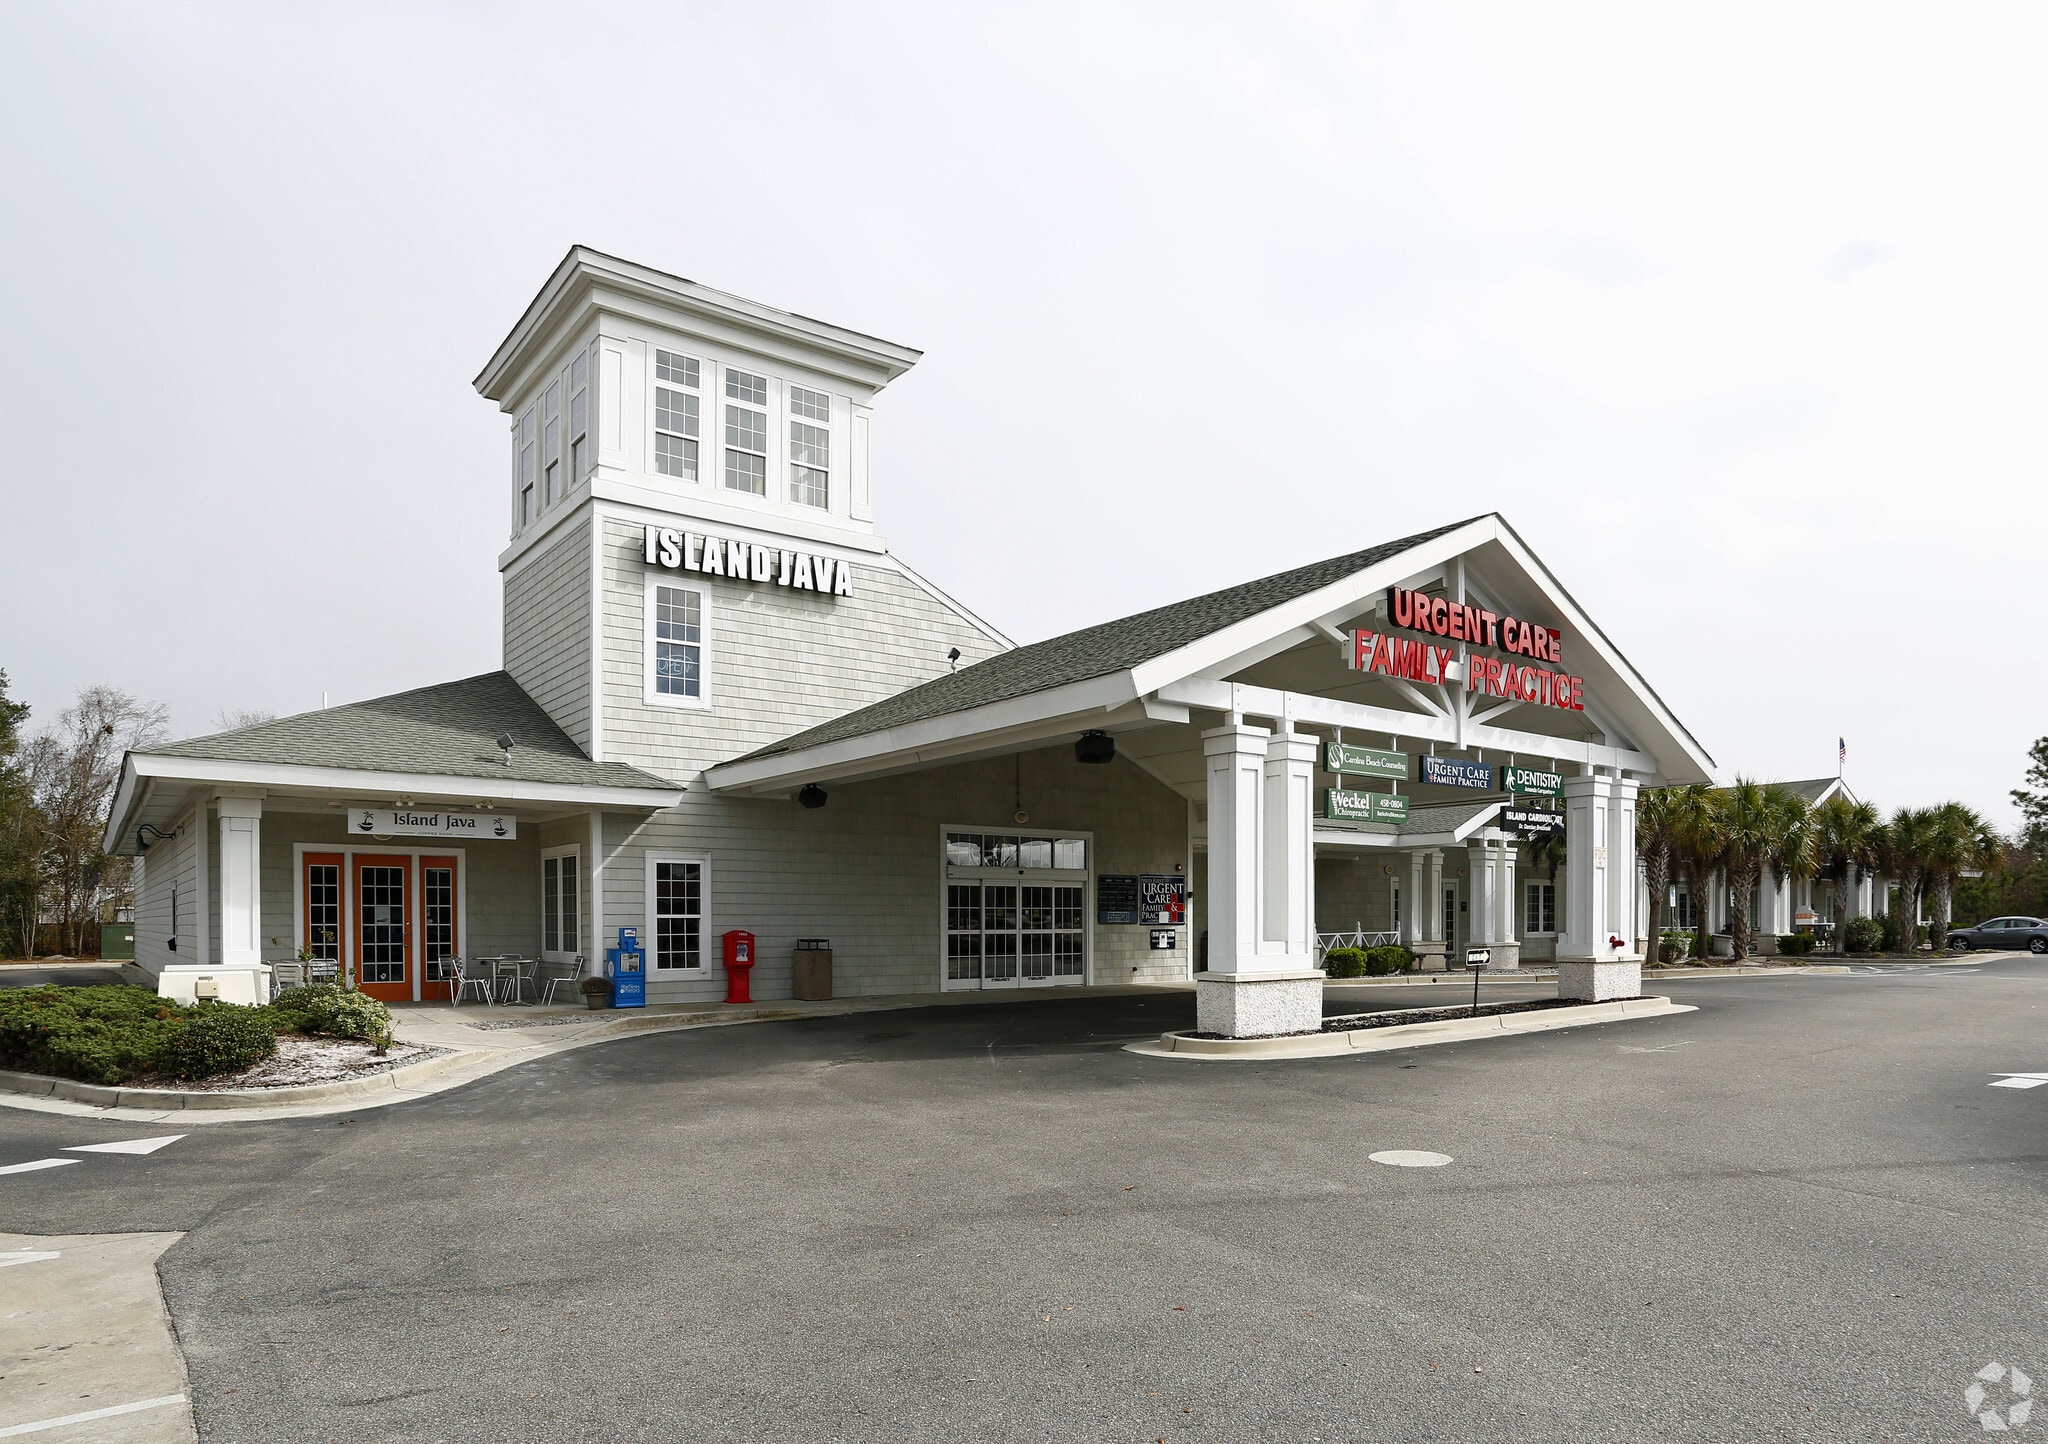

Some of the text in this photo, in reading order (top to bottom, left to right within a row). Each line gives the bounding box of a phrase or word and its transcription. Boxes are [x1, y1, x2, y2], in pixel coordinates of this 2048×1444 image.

[644, 524, 854, 597] ISLAND JAVA
[1391, 586, 1562, 663] URGENT CARE
[1352, 628, 1584, 712] FAMILY PRACTICE
[1344, 752, 1406, 772] Carolina Beach Counseling
[1427, 761, 1490, 781] URGENT CARE
[1433, 773, 1488, 789] FAMILY PRACTICE
[1517, 769, 1562, 789] DENTISTRY
[1331, 791, 1370, 809] Weckel
[393, 812, 476, 831] Island Java
[1337, 808, 1370, 818] Chiropractic
[1506, 811, 1527, 821] ISLAND
[1142, 883, 1184, 895] URGENT
[1142, 903, 1165, 912] FAMILY
[1147, 893, 1171, 904] CARE
[1170, 902, 1178, 912] &
